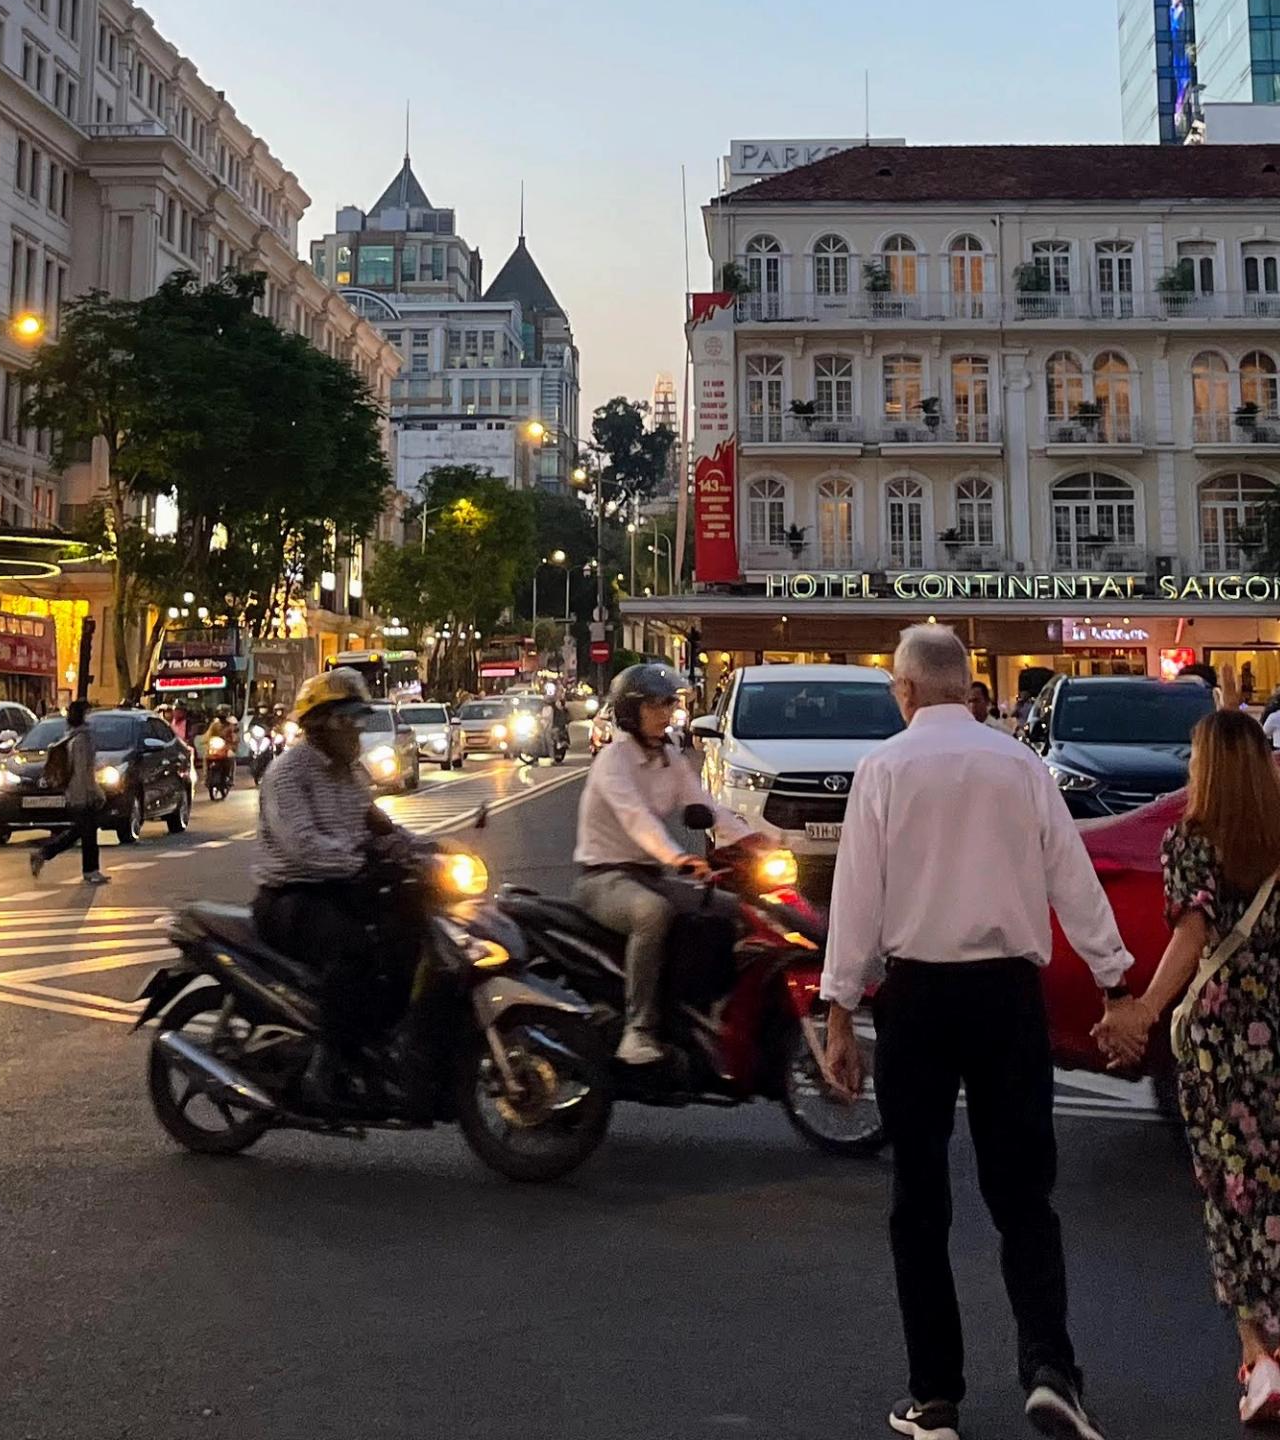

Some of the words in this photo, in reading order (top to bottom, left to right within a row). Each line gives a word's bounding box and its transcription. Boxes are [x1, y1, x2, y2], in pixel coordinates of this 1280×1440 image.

[766, 573, 879, 600] HOTEL
[893, 573, 1144, 600] CONTINENTAL
[168, 659, 200, 669] TikTok
[203, 658, 227, 669] Shop
